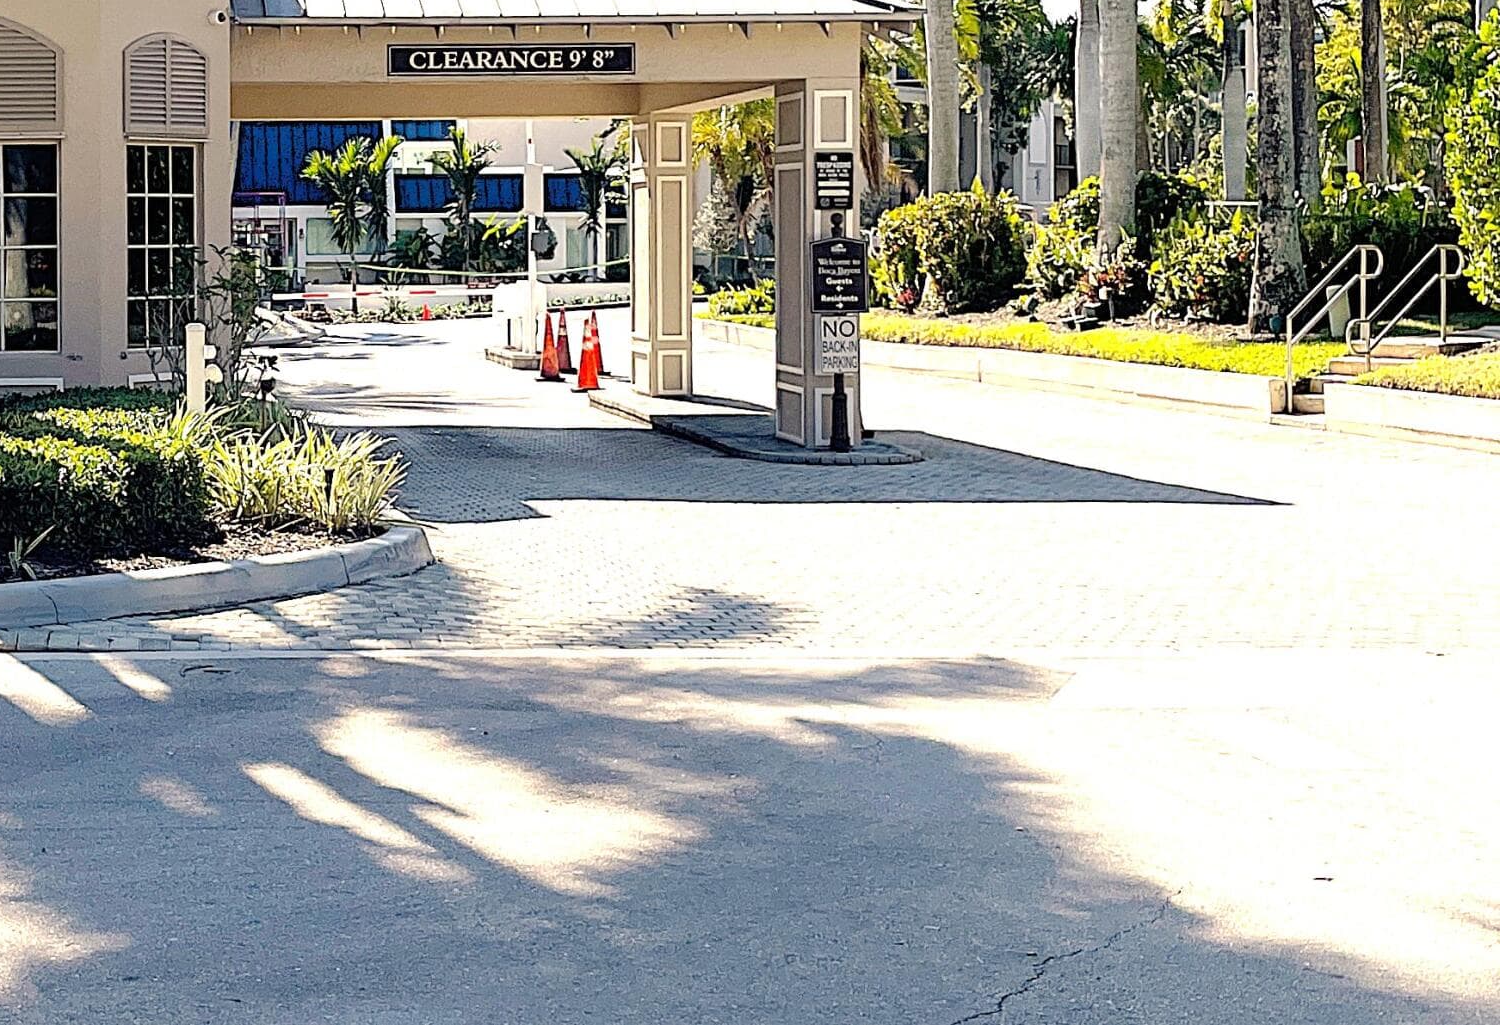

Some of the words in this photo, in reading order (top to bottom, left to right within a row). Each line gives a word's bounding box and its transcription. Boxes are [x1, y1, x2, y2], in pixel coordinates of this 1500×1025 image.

[409, 50, 563, 69] CLEARANCE
[826, 277, 853, 285] Guests
[821, 294, 858, 302] Residents
[823, 320, 856, 338] NO
[822, 340, 857, 353] BACK-IN
[822, 356, 858, 369] PARKING
